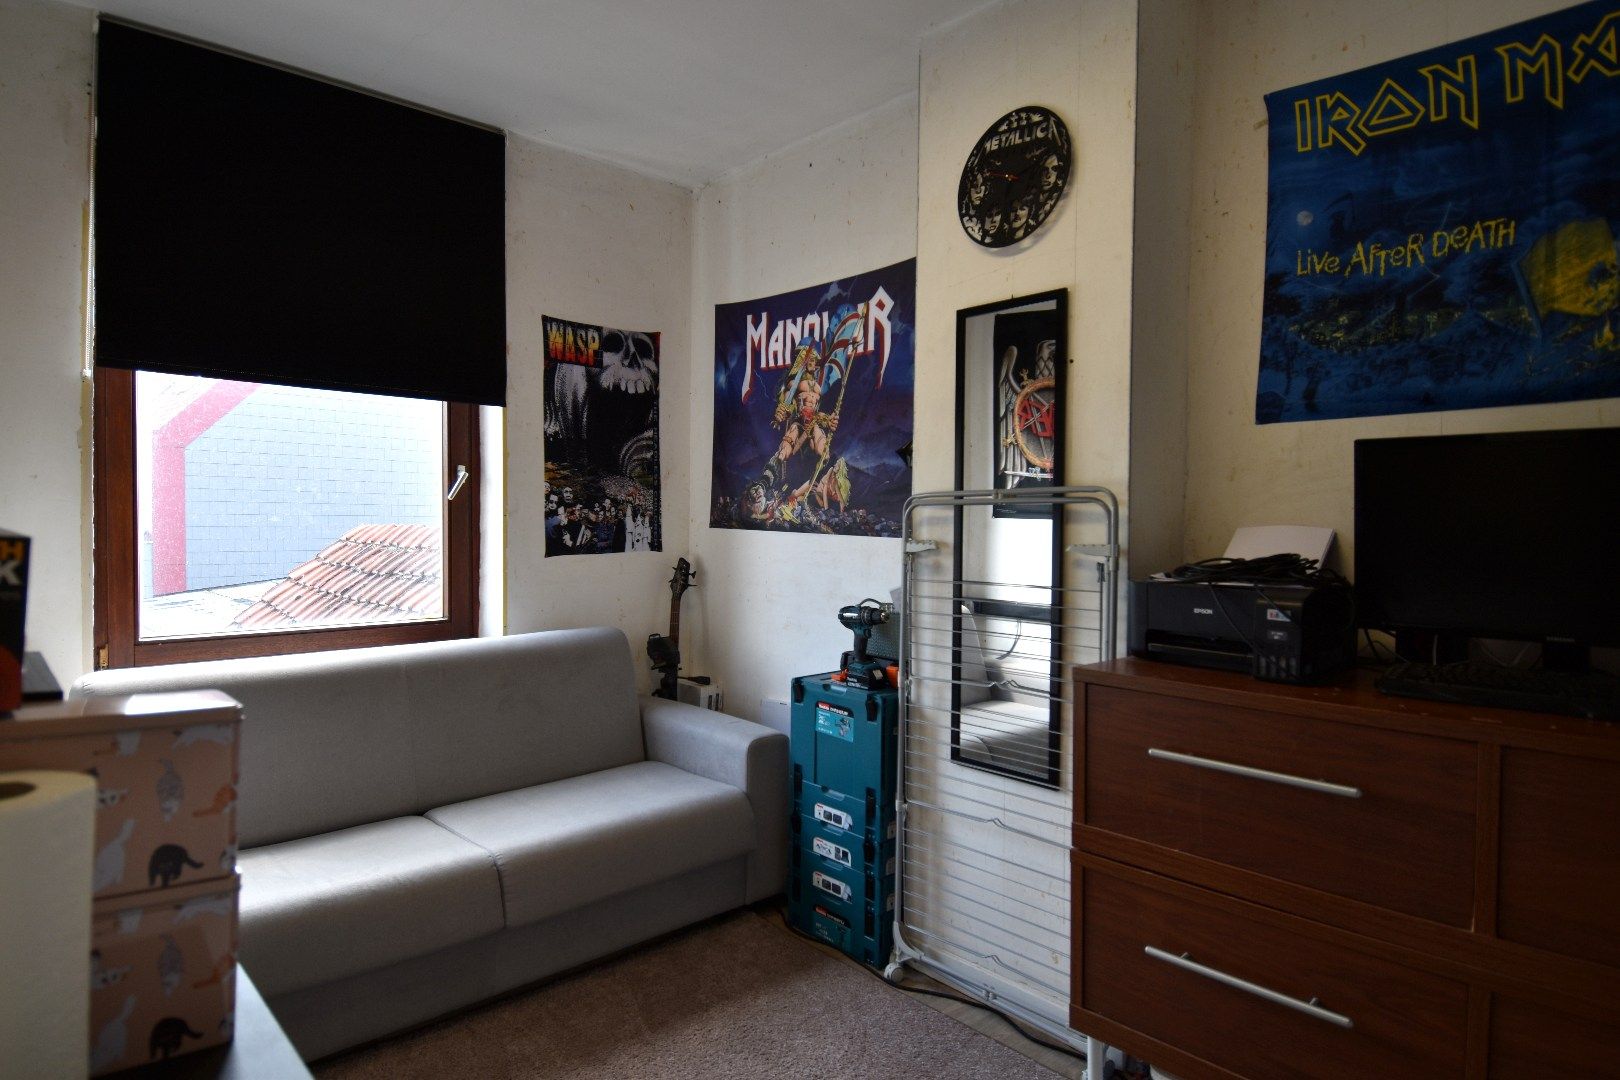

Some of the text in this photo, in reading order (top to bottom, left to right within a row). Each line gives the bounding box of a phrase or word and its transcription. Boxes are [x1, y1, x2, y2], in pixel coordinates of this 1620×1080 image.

[972, 115, 1062, 167] METALLICA
[1294, 54, 1479, 156] IRON
[546, 321, 600, 367] WASP
[741, 285, 895, 404] MANOR
